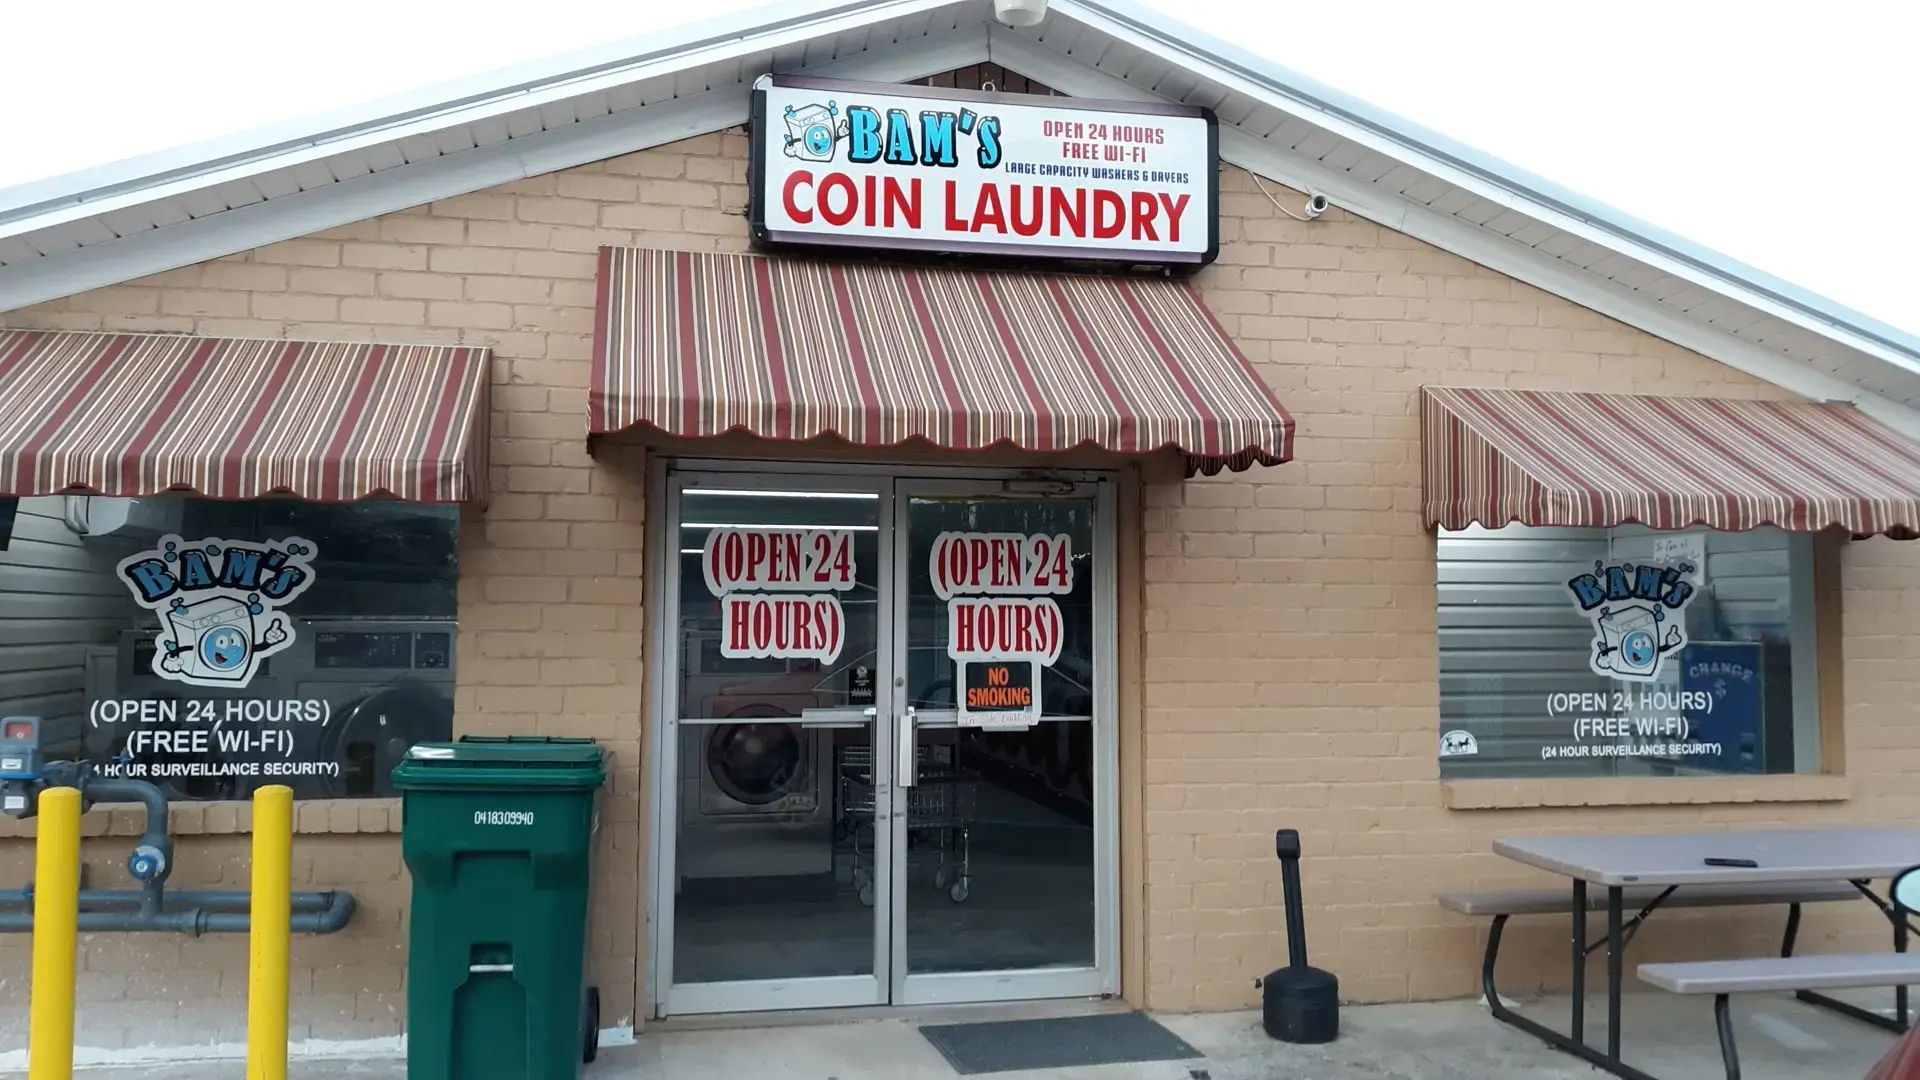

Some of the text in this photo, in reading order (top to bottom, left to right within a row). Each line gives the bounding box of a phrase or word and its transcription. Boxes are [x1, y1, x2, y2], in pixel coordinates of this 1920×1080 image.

[846, 105, 1002, 169] BAM'S
[1044, 120, 1165, 144] OPEN 24 HOURS
[1062, 142, 1146, 163] FREE WI-FI
[1005, 162, 1036, 175] LARGE
[1039, 165, 1089, 178] CAPACITY
[1092, 167, 1140, 181] WASHERS
[1151, 171, 1189, 184] DRYERS
[783, 169, 1192, 243] COIN LAUNDRY
[711, 531, 851, 588] (OPEN 24
[937, 537, 1069, 592] (OPEN 24
[125, 547, 306, 602] BAM'S
[1568, 565, 1693, 610] BAM'S
[730, 600, 840, 657] HOURS)
[956, 604, 1059, 659] HOURS)
[988, 667, 1010, 686] NO
[1689, 661, 1754, 682] CHANGE
[967, 687, 1031, 707] SMOKING
[1547, 691, 1713, 717] (OPEN 24 HOURS)
[90, 699, 331, 728] (OPEN 24 HOURS)
[1573, 716, 1689, 741] (FREE WI-FI)
[126, 729, 294, 758] (FREE WI-FI)
[1541, 742, 1722, 760] (24 HOUR SURVEILLANCE SECURITY)
[151, 762, 260, 777] SURVEILLANCE
[263, 761, 340, 778] SECURITY)
[474, 811, 534, 825] 0418309940
